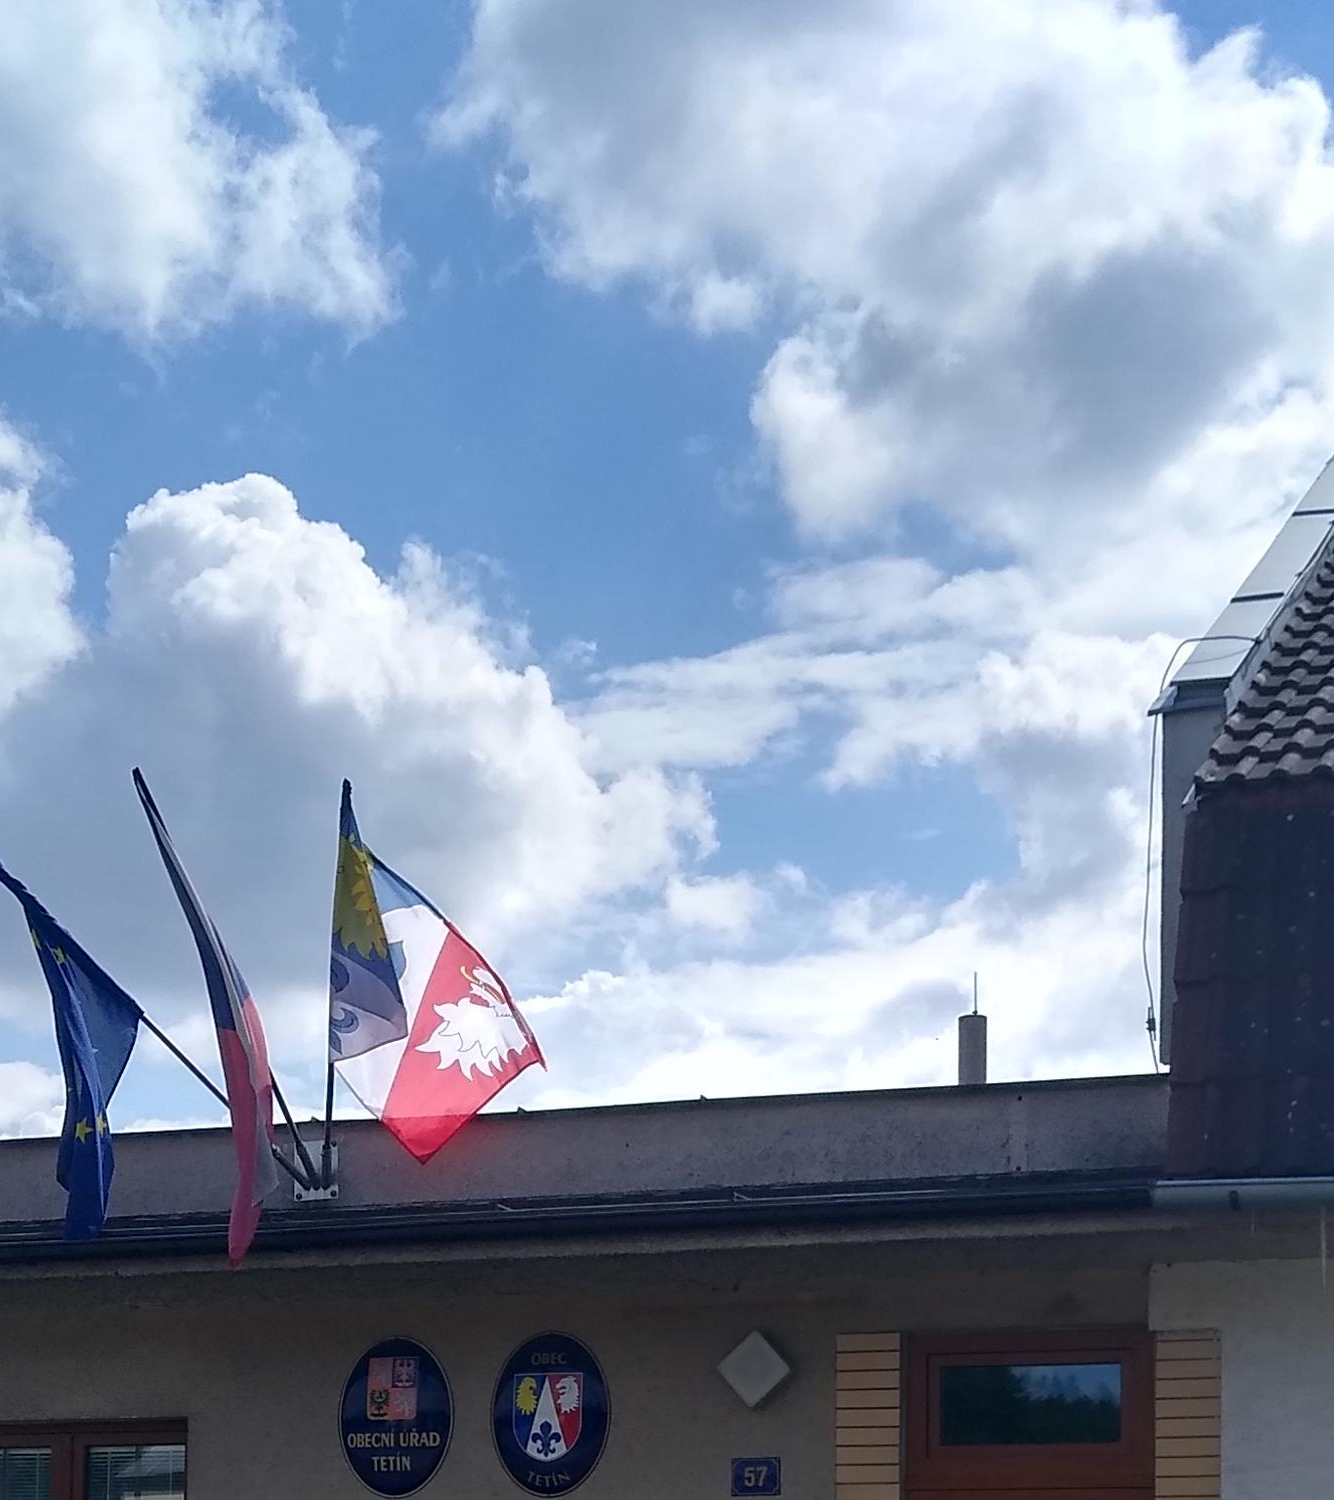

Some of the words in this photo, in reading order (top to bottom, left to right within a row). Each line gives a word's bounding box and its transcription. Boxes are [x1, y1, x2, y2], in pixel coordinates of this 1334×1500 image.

[531, 1352, 567, 1366] OBEC
[347, 1428, 394, 1448] OBECNÍ
[372, 1452, 411, 1472] TETÍN
[526, 1470, 571, 1488] TETÍN
[744, 1466, 768, 1487] 57
